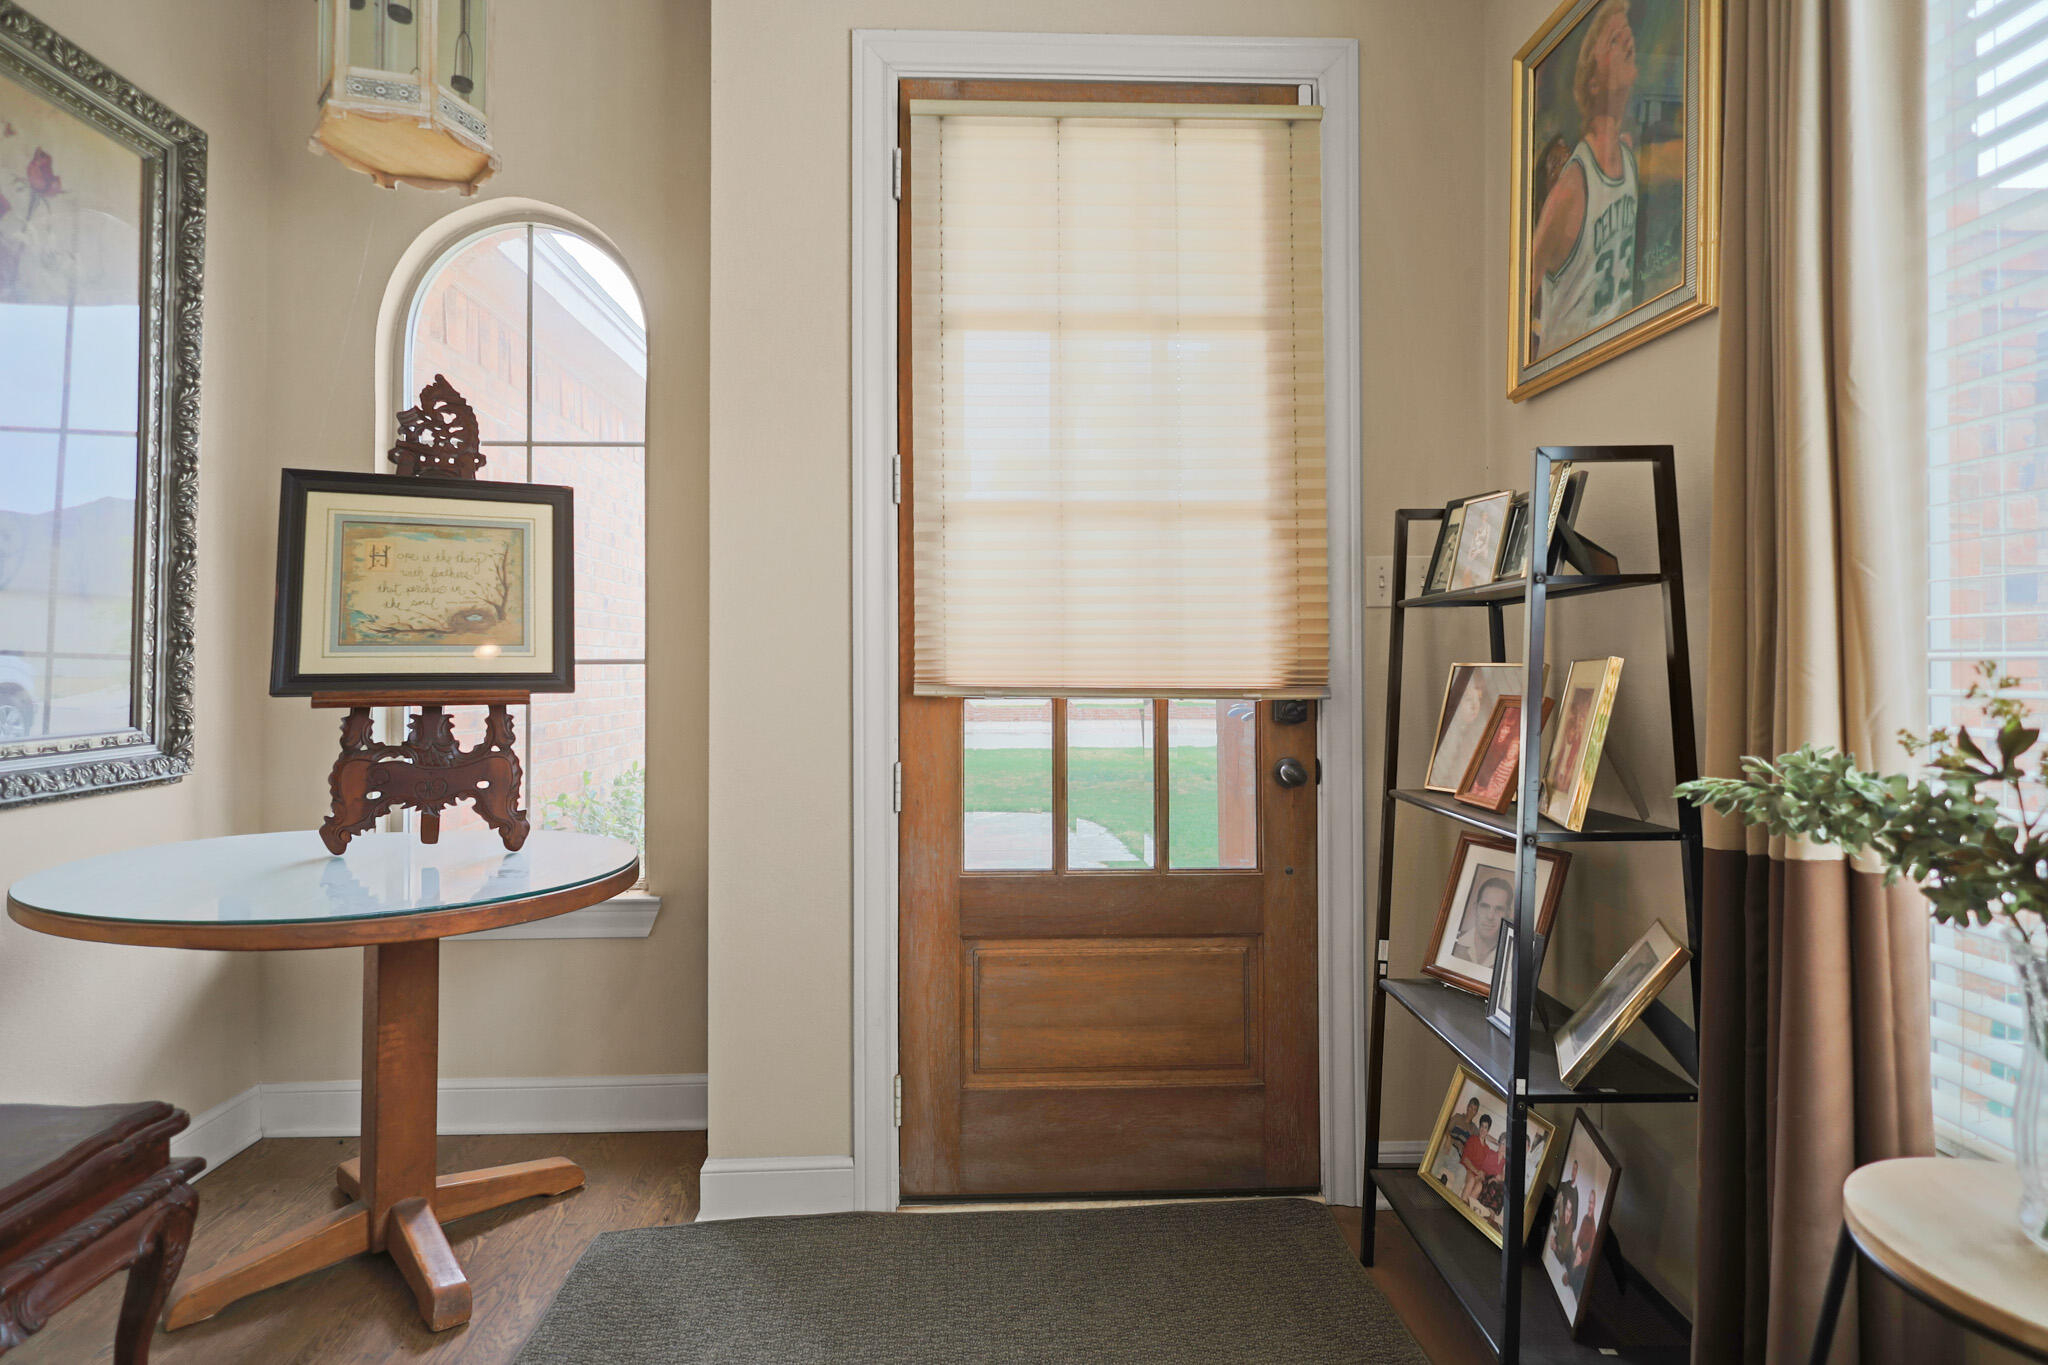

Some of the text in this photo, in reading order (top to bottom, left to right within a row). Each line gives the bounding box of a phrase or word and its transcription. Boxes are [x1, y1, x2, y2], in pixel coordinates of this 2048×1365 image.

[436, 549, 451, 563] the
[456, 550, 487, 575] thing
[377, 581, 402, 596] that
[410, 597, 436, 608] soul
